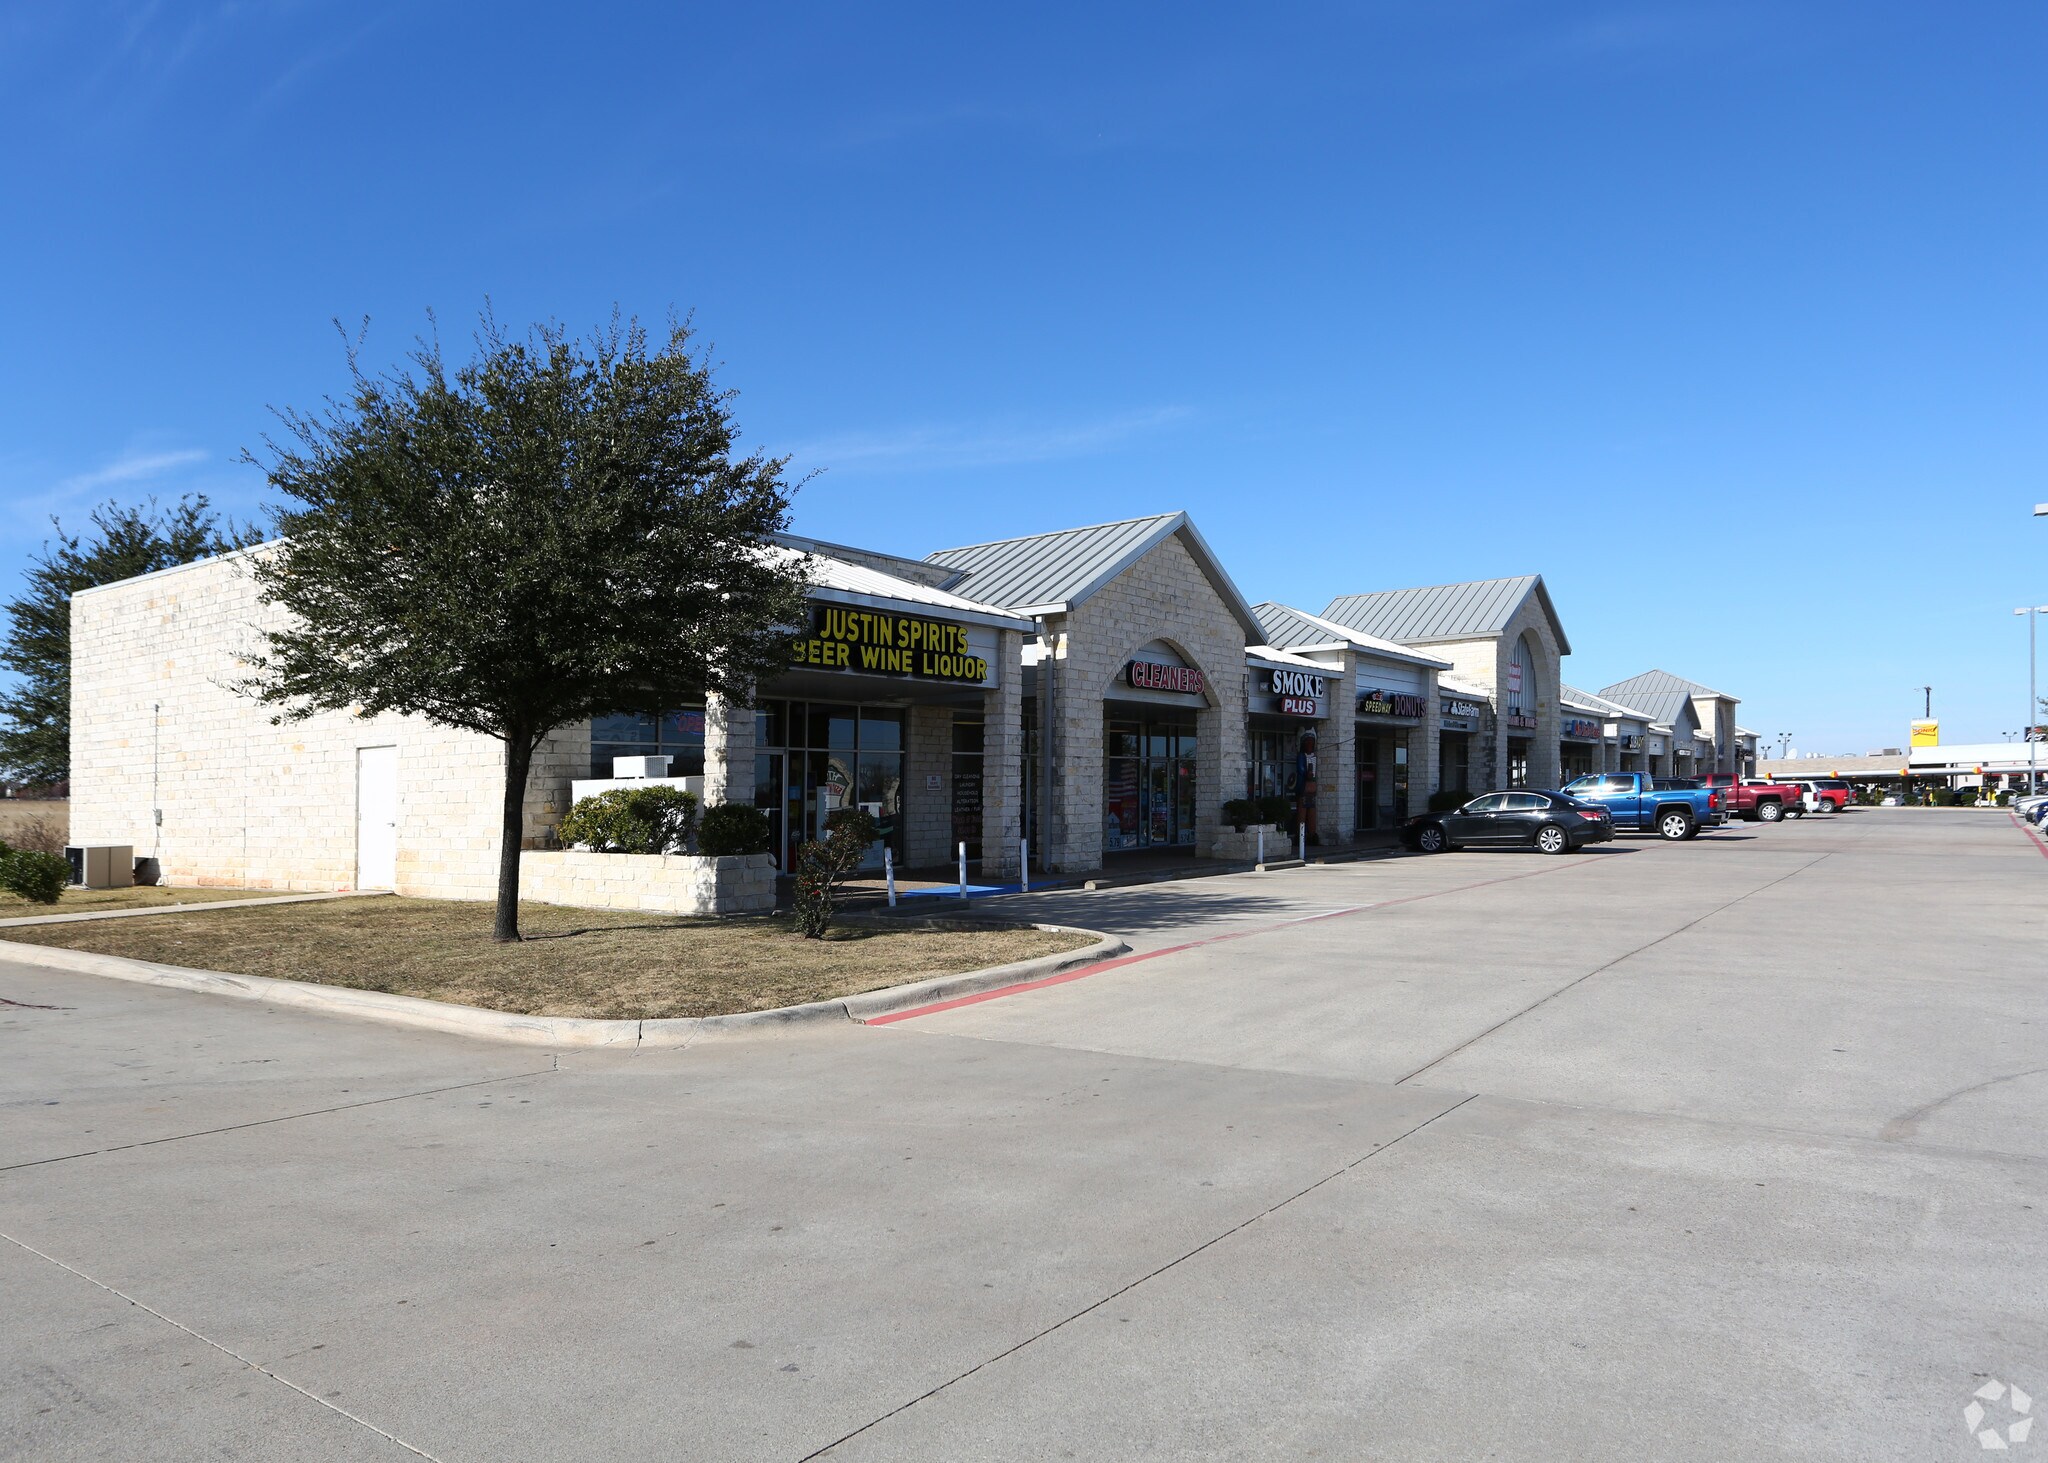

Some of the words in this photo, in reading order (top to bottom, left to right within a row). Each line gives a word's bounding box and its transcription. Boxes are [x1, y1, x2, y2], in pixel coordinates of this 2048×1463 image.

[820, 608, 893, 646] JUSTIN
[898, 619, 968, 655] SPIRITS
[792, 639, 850, 667] BEER
[860, 645, 913, 673] WINE
[923, 652, 987, 680] LIQUOR
[1132, 662, 1205, 693] CLEANERS
[1272, 670, 1324, 698] SMOKE
[1284, 699, 1314, 714] PLUS
[1365, 700, 1393, 714] SPEEDWAY
[1394, 695, 1427, 718] DONUTS
